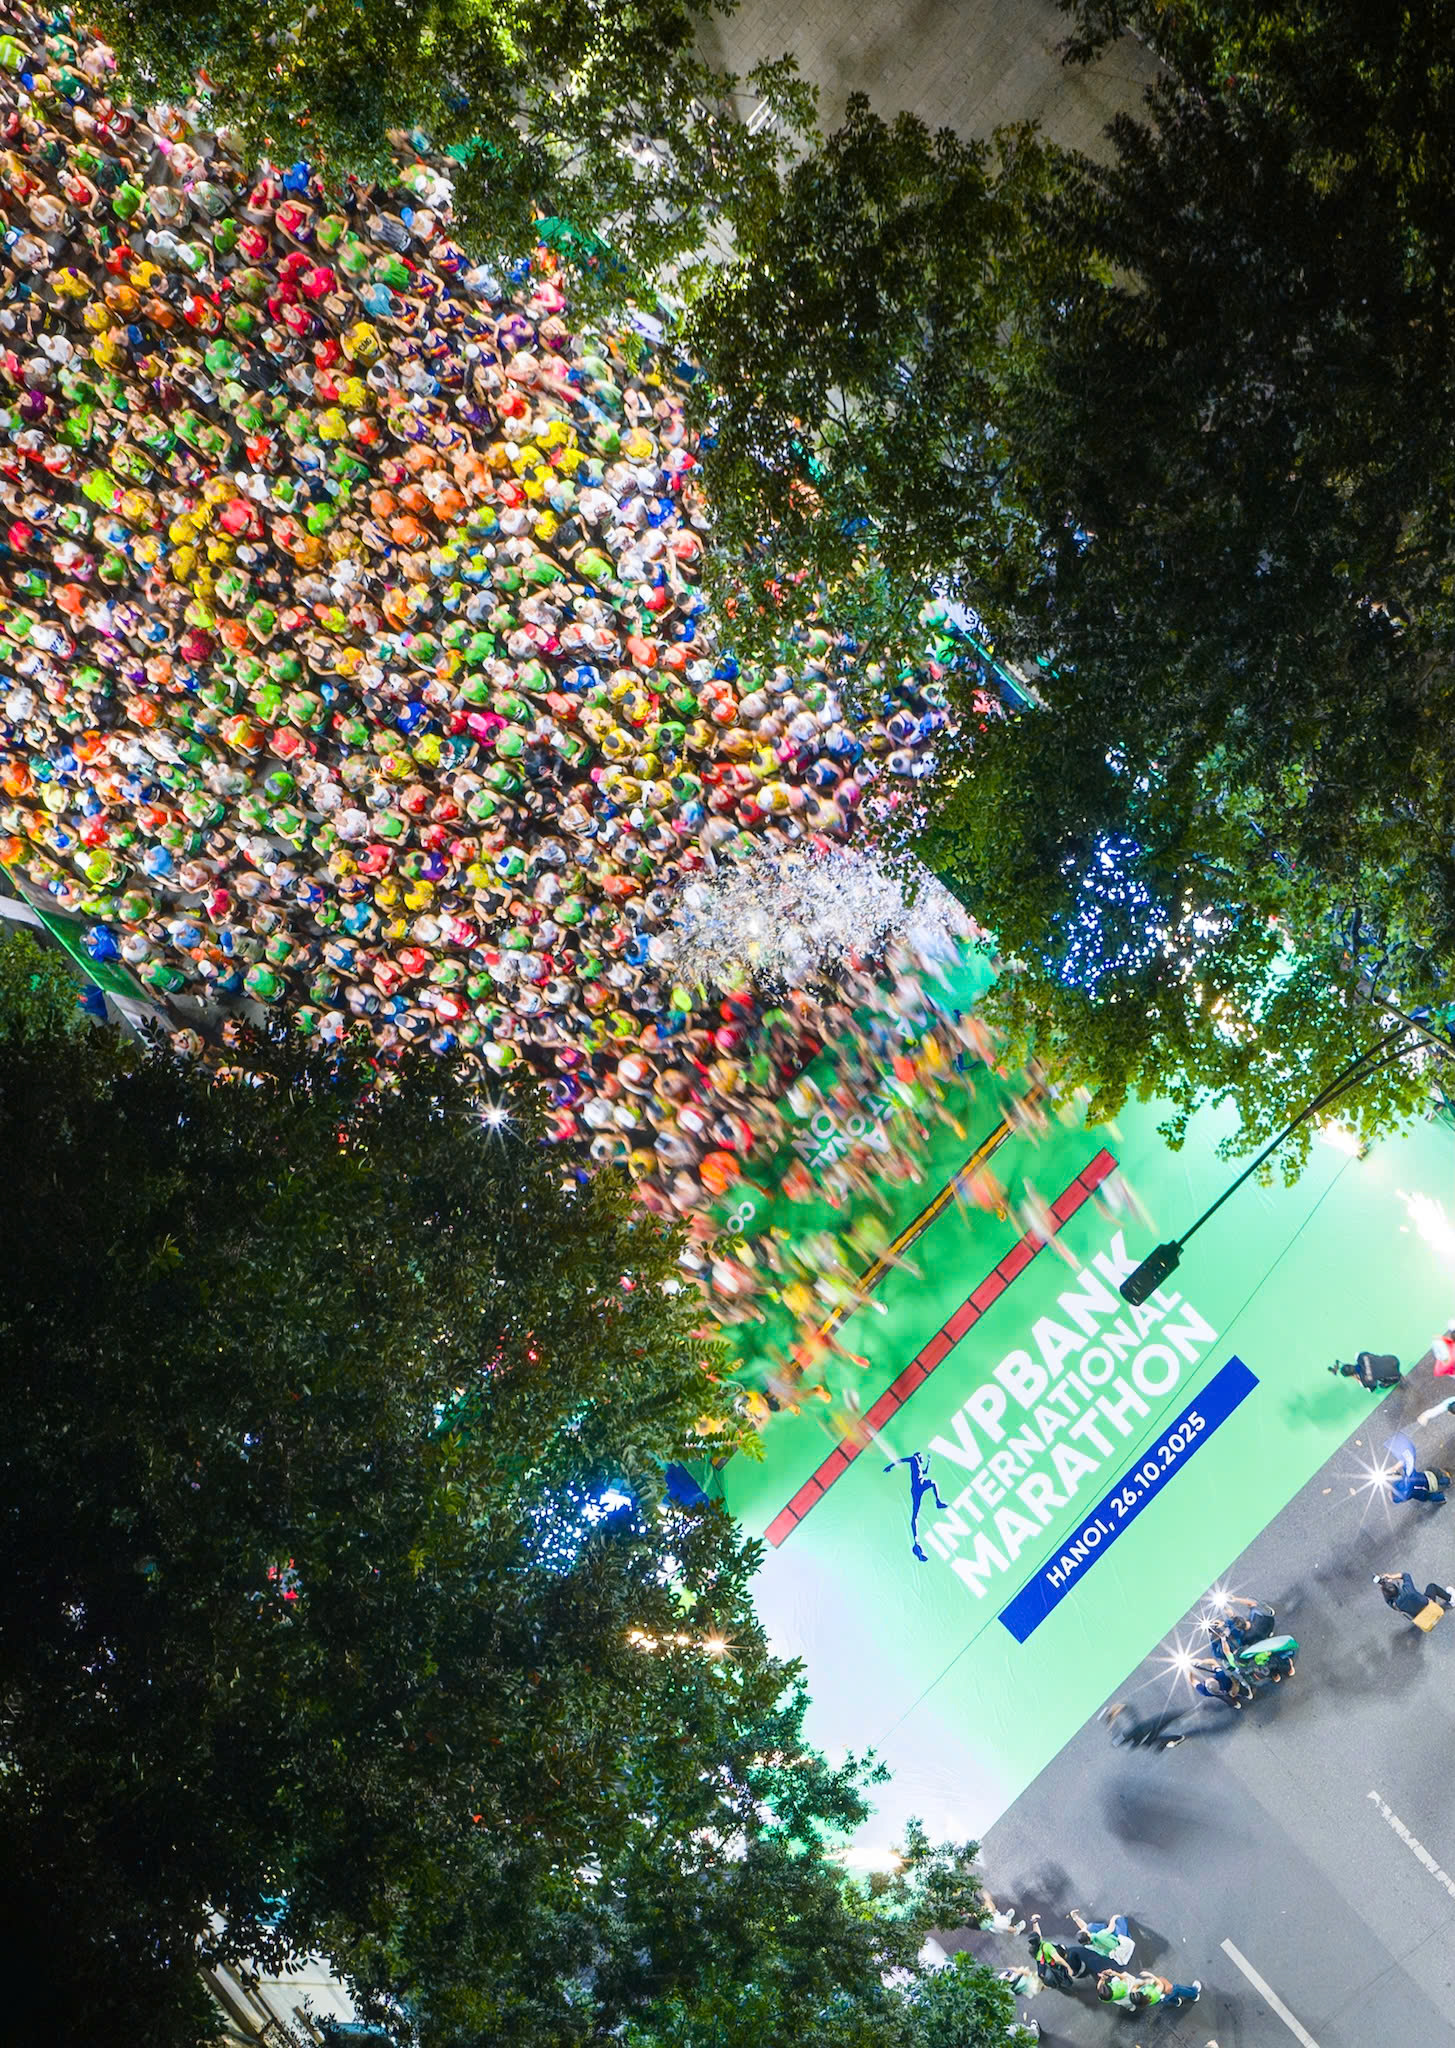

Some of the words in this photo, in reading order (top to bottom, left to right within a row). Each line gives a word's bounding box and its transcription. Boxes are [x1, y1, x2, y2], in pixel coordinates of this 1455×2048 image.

[923, 1290, 1183, 1561] INTERNATIONAL
[926, 1228, 1141, 1471] VPBANK
[950, 1301, 1219, 1599] MARATHON
[1046, 1518, 1115, 1588] HANOI,
[1110, 1411, 1206, 1518] 26.10.2025
